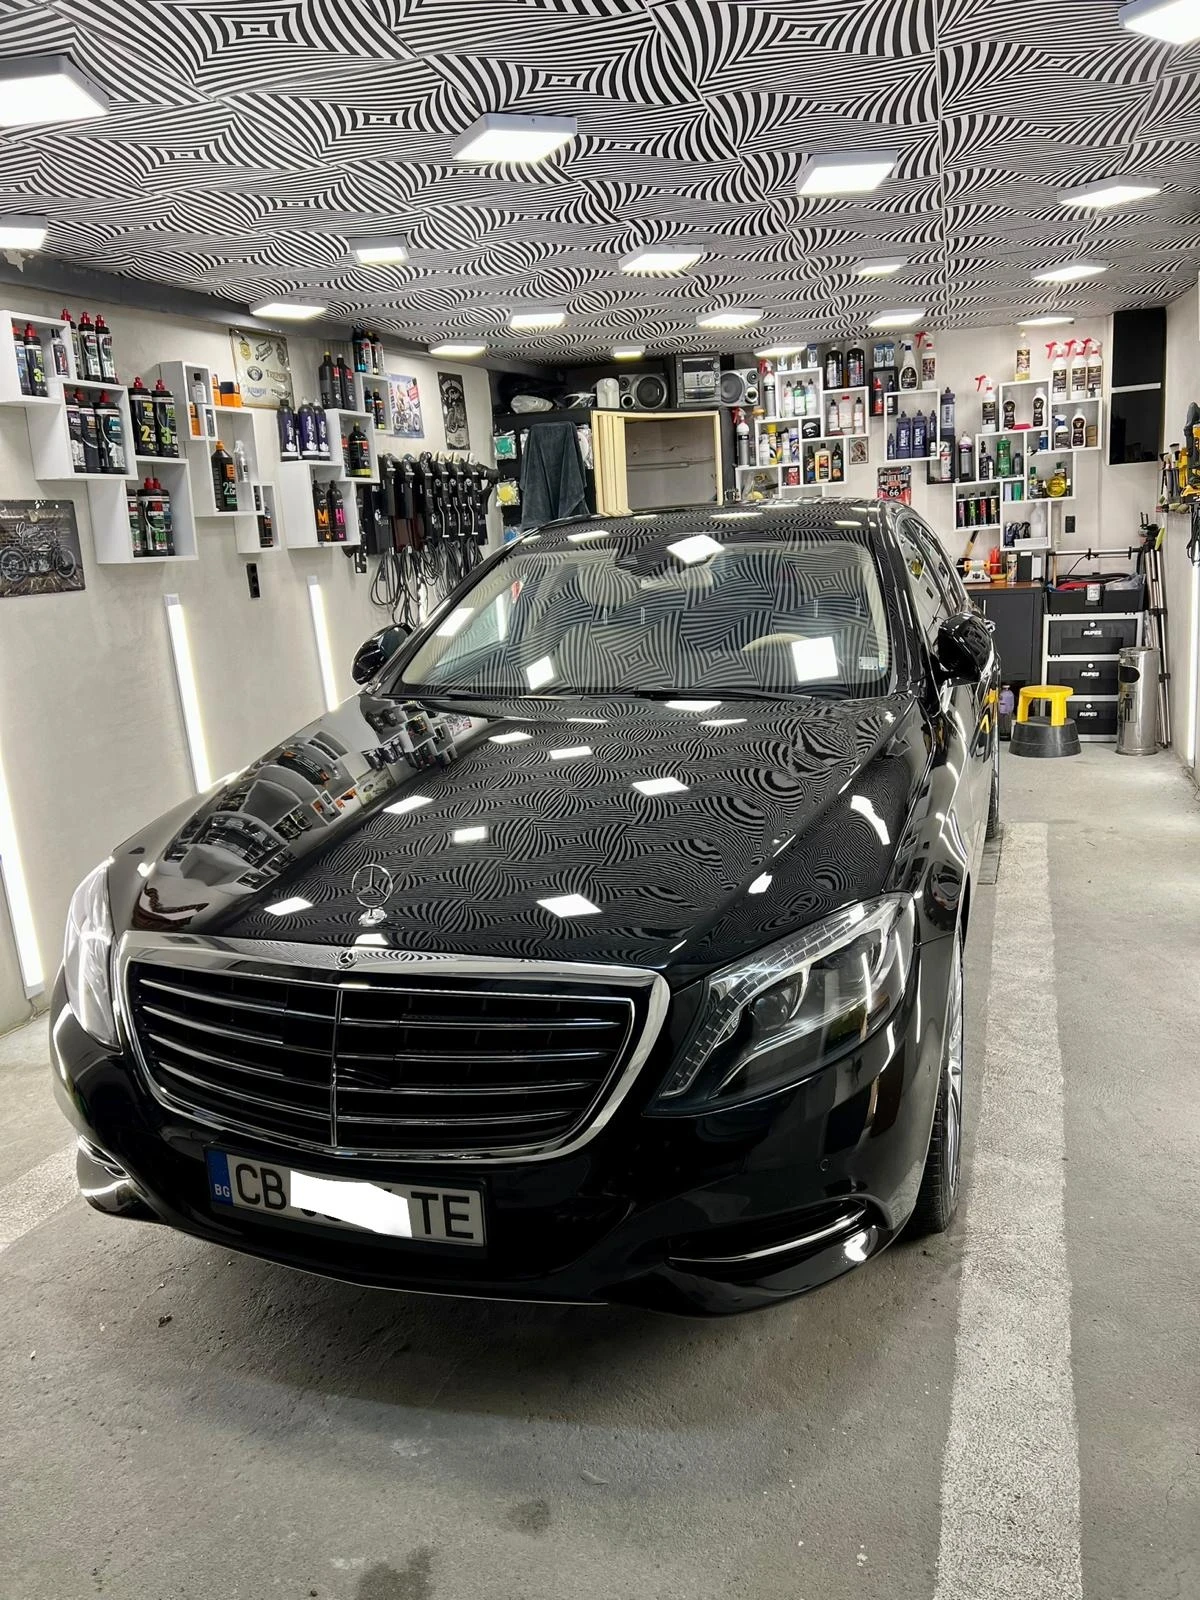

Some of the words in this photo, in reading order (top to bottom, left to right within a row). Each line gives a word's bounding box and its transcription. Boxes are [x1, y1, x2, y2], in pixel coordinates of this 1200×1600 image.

[889, 489, 900, 497] 66
[214, 1183, 230, 1197] BG
[235, 1163, 287, 1210] CB
[411, 1191, 474, 1240] TE
